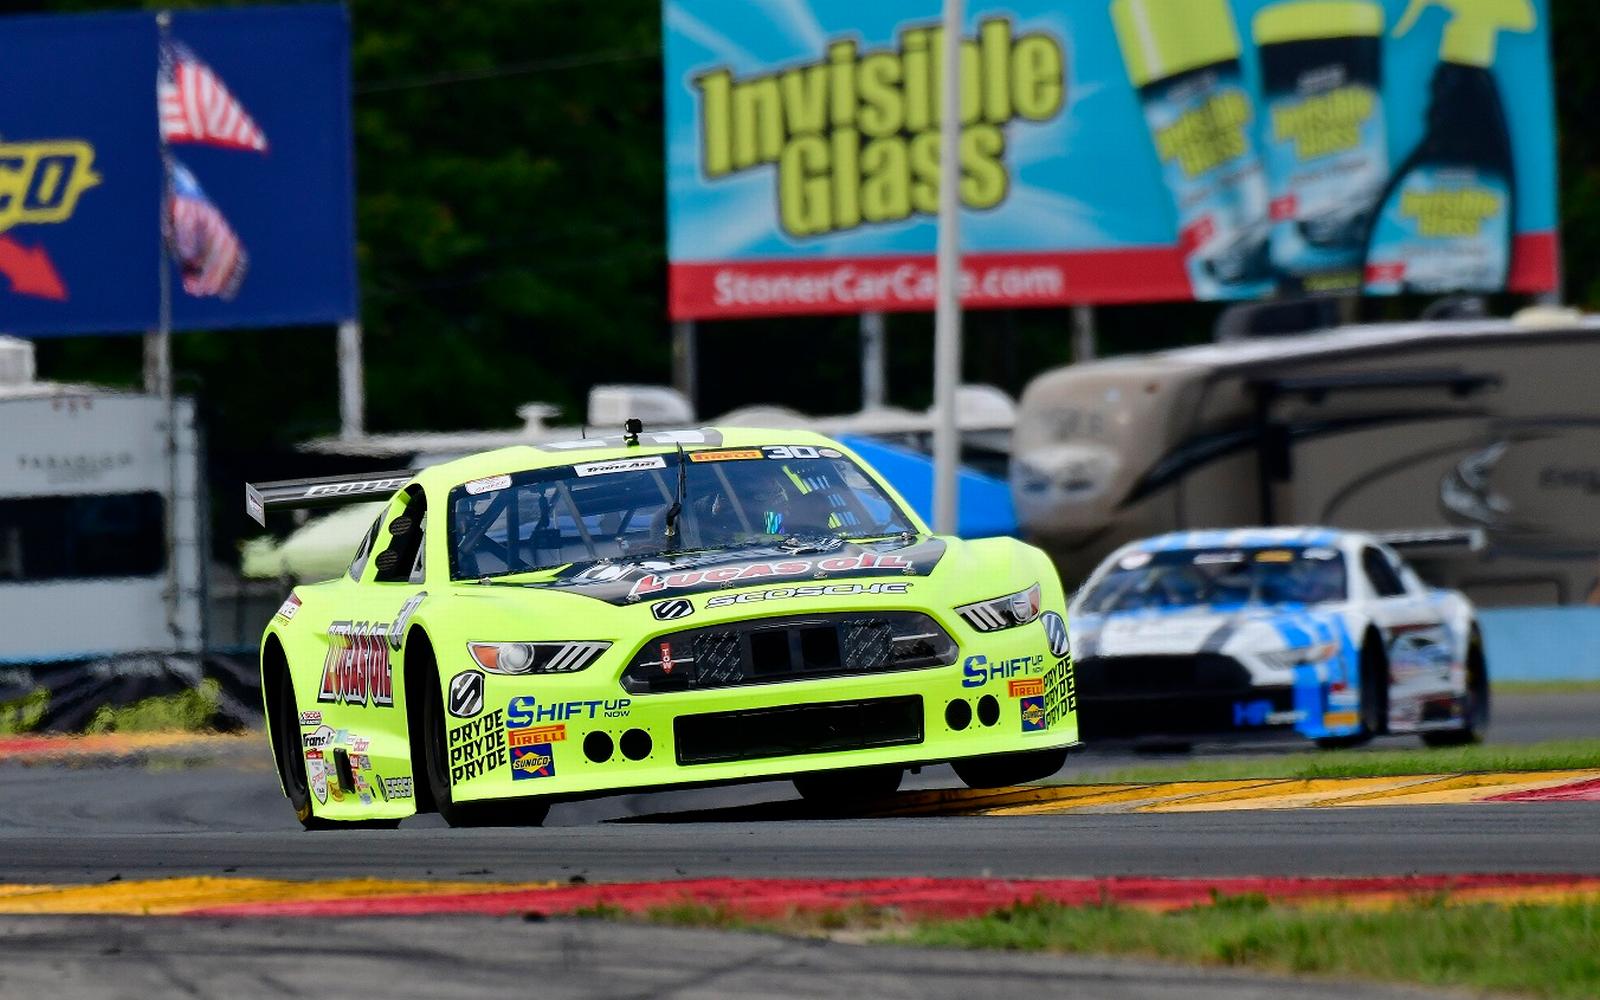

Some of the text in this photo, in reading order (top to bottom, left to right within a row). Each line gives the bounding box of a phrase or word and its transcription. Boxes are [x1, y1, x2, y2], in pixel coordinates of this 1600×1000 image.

[694, 18, 1064, 178] Invisible
[780, 124, 1008, 237] Glass
[714, 267, 1063, 305] StonerCarCae.com
[762, 445, 820, 460] 30
[629, 552, 912, 595] LUCAS OIL
[705, 582, 913, 609] SCOSCHE
[662, 648, 672, 671] TOW
[962, 655, 1043, 688] SHIFT UP
[1043, 655, 1072, 692] PRYDE
[1008, 678, 1043, 697] PIRELLI
[1045, 672, 1075, 709] PRYDE
[449, 708, 504, 748] PRYDE
[505, 696, 631, 728] SHIFT UP
[604, 710, 630, 718] NOW
[1046, 696, 1077, 730] PRYDE
[450, 728, 505, 768] PRYDE
[509, 724, 565, 746] PIRELLI
[451, 747, 507, 786] PRYDE
[513, 756, 551, 770] SUNOCO
